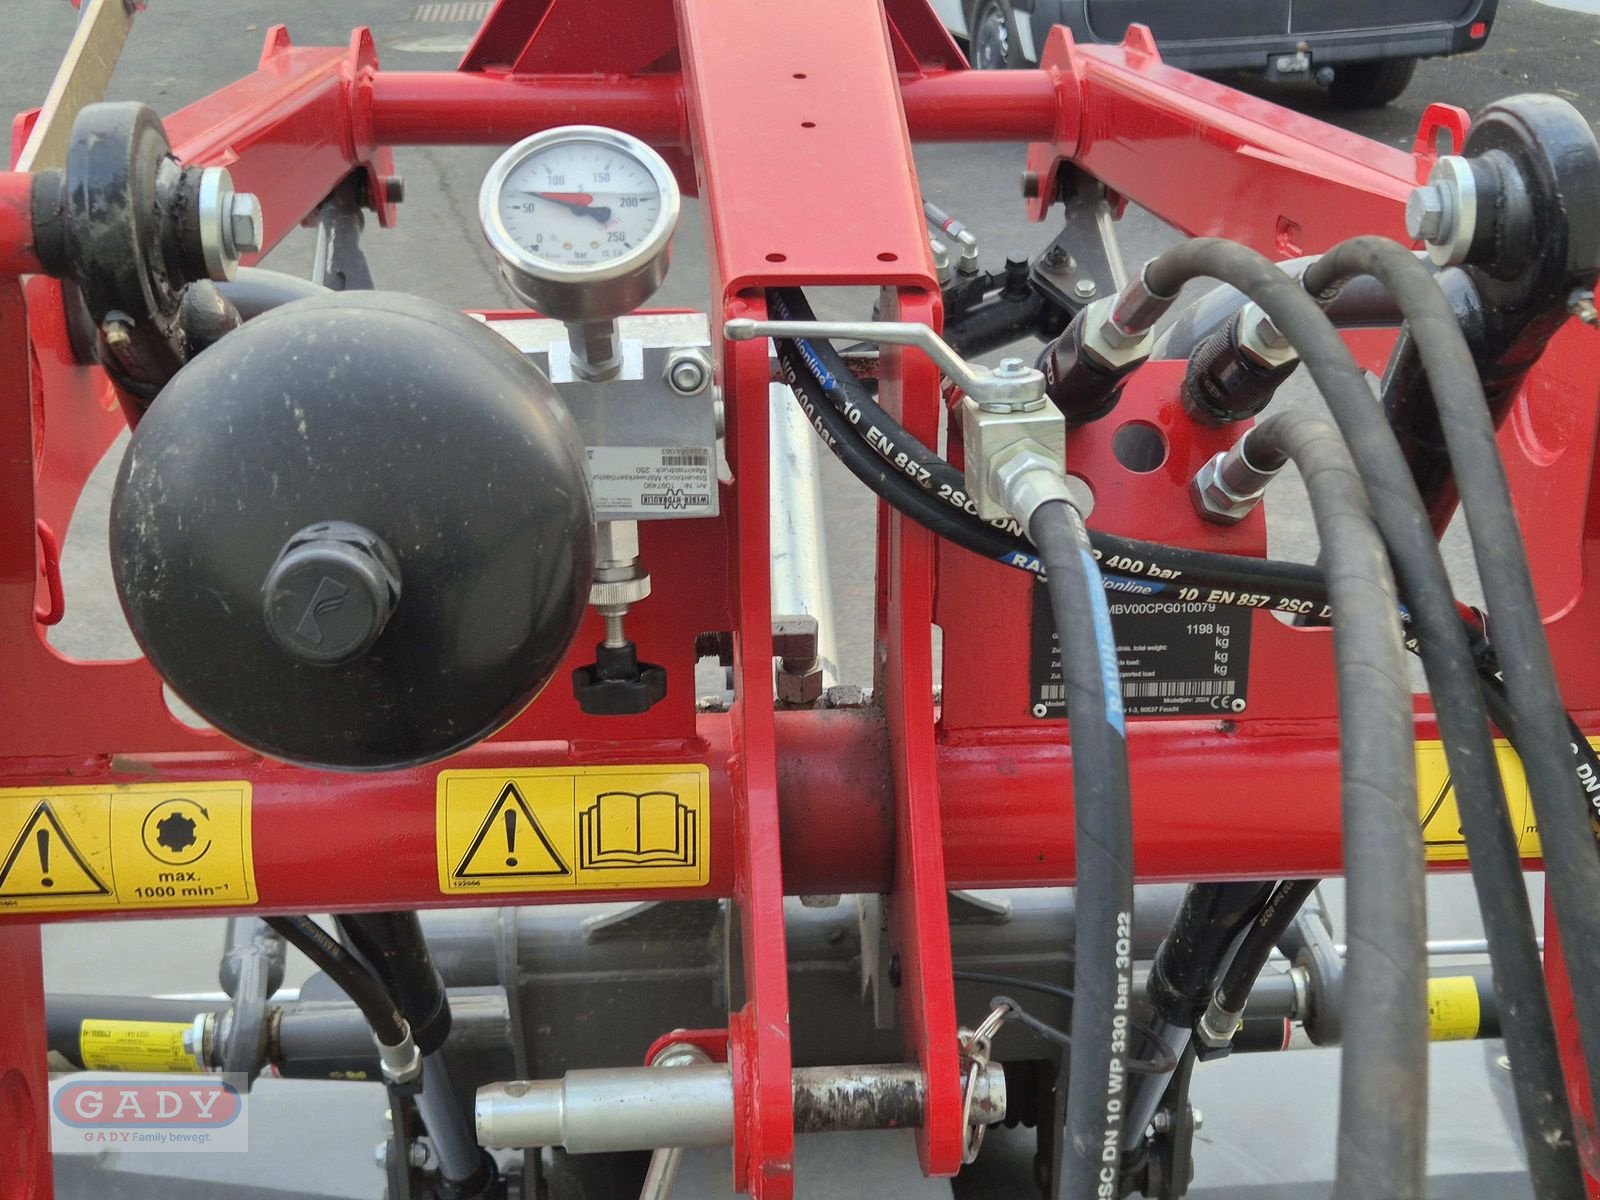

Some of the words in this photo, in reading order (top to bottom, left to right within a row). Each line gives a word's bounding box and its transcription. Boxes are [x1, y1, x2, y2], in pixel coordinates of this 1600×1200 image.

[546, 175, 565, 186] 100
[592, 173, 610, 184] 150
[522, 203, 535, 214] 50
[619, 197, 638, 208] 200
[536, 233, 543, 244] 0
[606, 231, 625, 242] 250
[573, 250, 588, 259] bar
[635, 466, 650, 474] 250
[663, 474, 708, 482] Steuerblock
[782, 355, 797, 384] WP
[794, 387, 815, 419] 400
[814, 415, 837, 447] bar
[1178, 587, 1200, 601] 10
[1207, 589, 1236, 605] EN
[1236, 592, 1271, 608] 857
[1276, 597, 1314, 614] 2SC
[843, 401, 861, 425] 10
[865, 425, 895, 457] EN
[894, 452, 932, 482] 857
[937, 483, 978, 516] 2SC
[990, 519, 1024, 537] DN
[1105, 555, 1144, 574] 400
[1147, 563, 1183, 580] bar
[1186, 624, 1214, 635] 1198
[1216, 623, 1230, 636] kg
[1215, 636, 1229, 648] kg
[1214, 651, 1229, 663] kg
[1213, 664, 1228, 676] kg
[1575, 763, 1600, 793] DN
[158, 870, 201, 882] max.
[134, 886, 176, 898] 1000
[1115, 911, 1132, 969] 3Q22
[1114, 974, 1130, 1010] bar
[1111, 1015, 1128, 1053] 330
[1107, 1058, 1125, 1094] WP
[1106, 1099, 1122, 1123] 10
[1102, 1130, 1119, 1162] DN
[1097, 1167, 1115, 1200] SC
